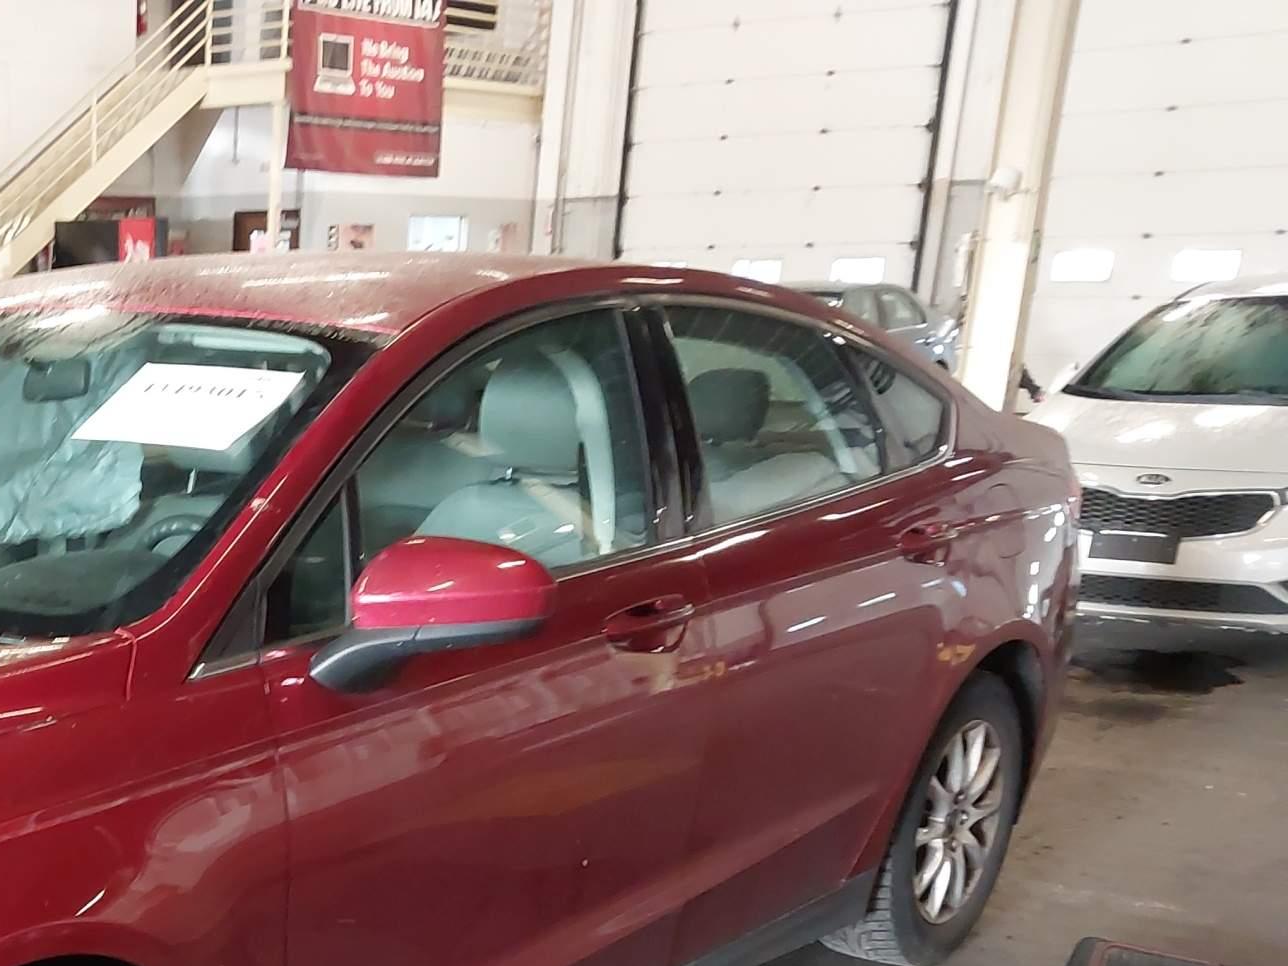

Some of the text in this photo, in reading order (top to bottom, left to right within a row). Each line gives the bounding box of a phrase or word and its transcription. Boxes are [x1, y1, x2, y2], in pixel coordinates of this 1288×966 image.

[379, 40, 410, 64] Bring
[361, 59, 425, 82] The Auction
